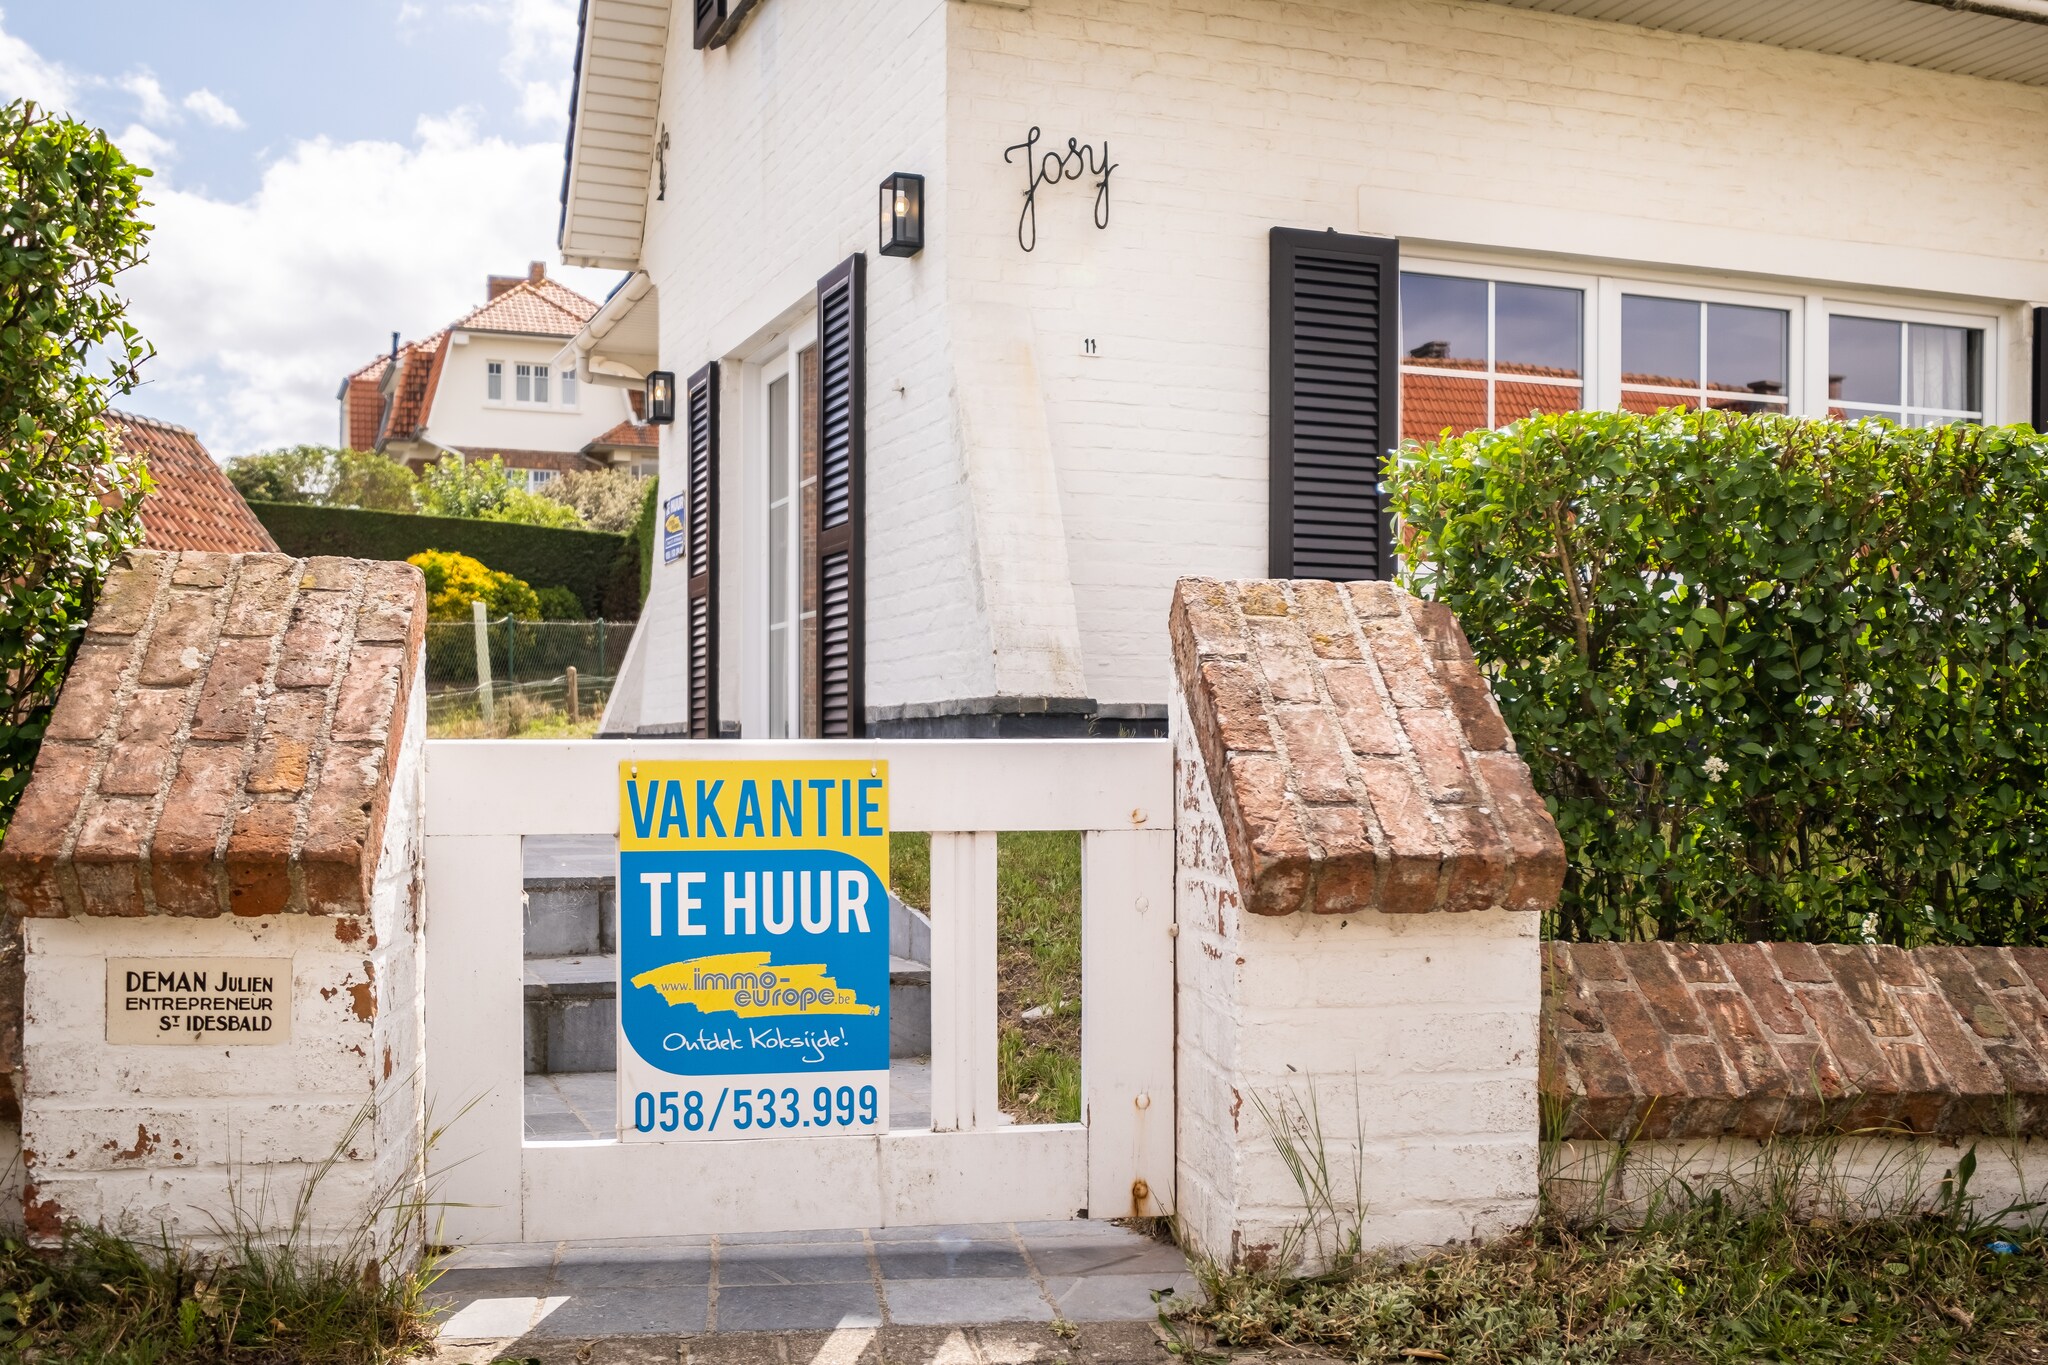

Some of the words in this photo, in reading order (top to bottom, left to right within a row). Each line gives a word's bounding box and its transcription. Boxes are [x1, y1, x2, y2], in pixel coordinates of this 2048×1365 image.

[1004, 125, 1119, 252] Josy
[1084, 338, 1097, 354] 11
[626, 779, 883, 839] VAKANTIE
[640, 871, 707, 937] TE
[724, 870, 871, 935] HUUR
[126, 971, 206, 992] DEMAN
[126, 997, 273, 1011] ENTREPRENEUR
[734, 987, 851, 1012] europe.be
[186, 1015, 272, 1032] IDESBALD
[662, 1028, 744, 1052] Ontdek
[749, 1026, 849, 1064] Koksijde!
[634, 1084, 878, 1133] 058/533.999
